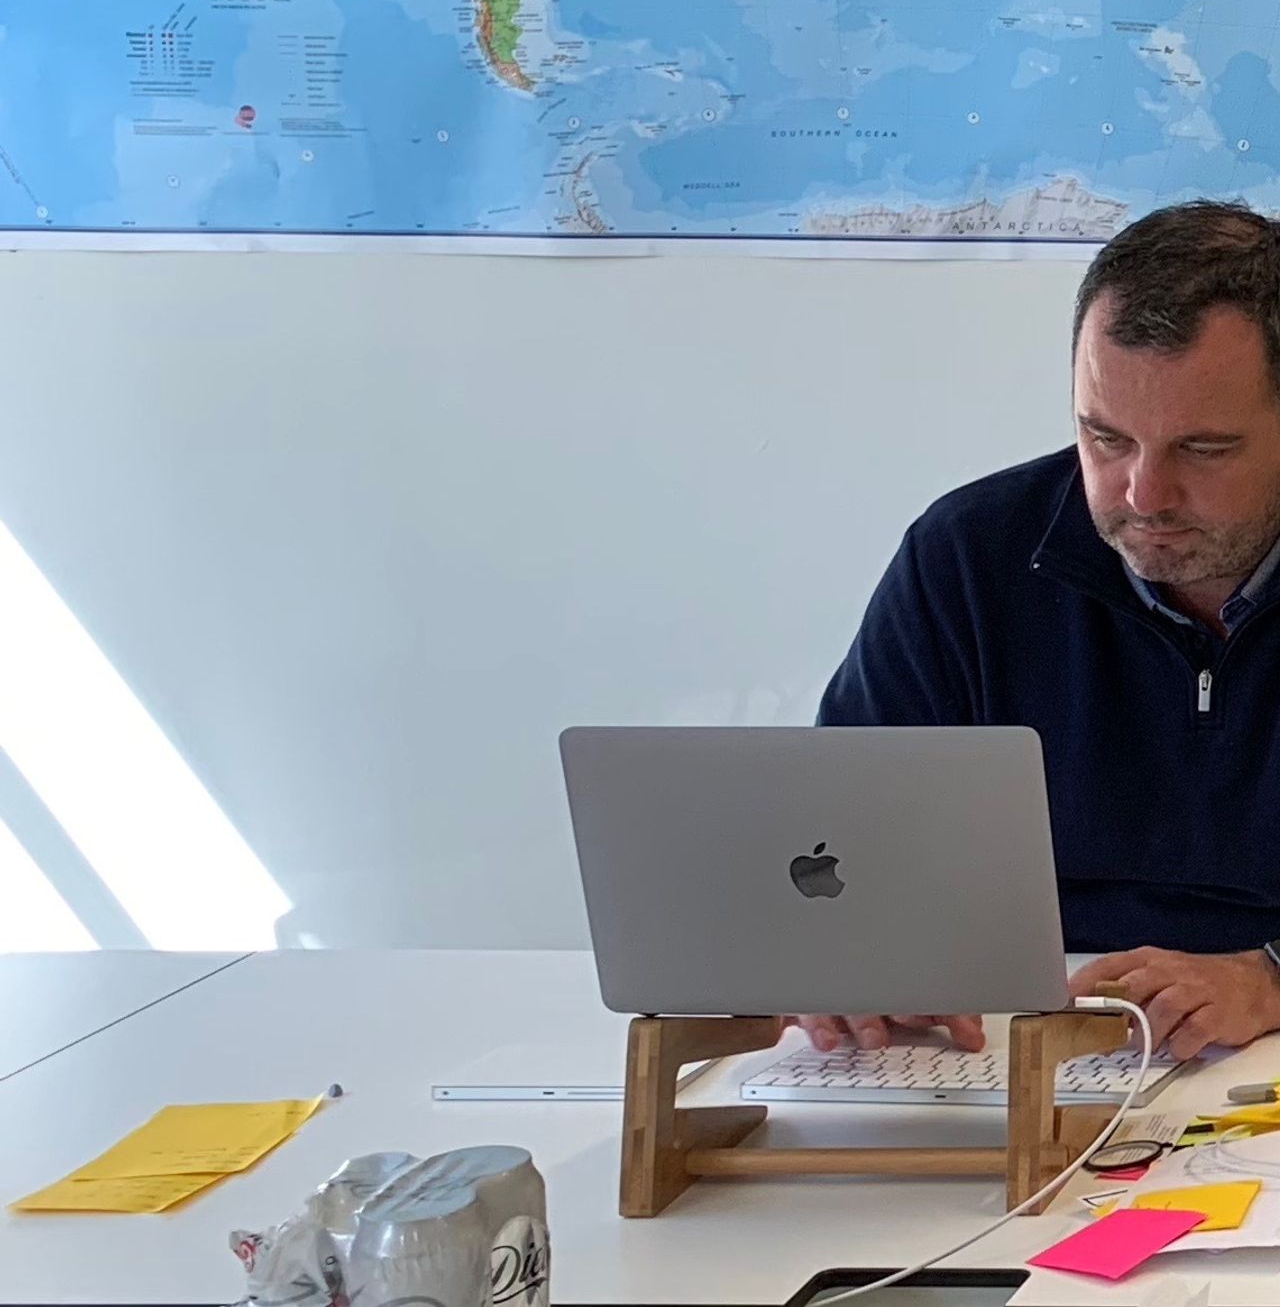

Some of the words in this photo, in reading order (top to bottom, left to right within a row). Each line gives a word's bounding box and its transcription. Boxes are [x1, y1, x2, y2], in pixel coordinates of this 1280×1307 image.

[771, 129, 841, 138] SOUTHERN
[856, 129, 899, 138] OCEAN
[952, 221, 1083, 232] ANTARCTICA
